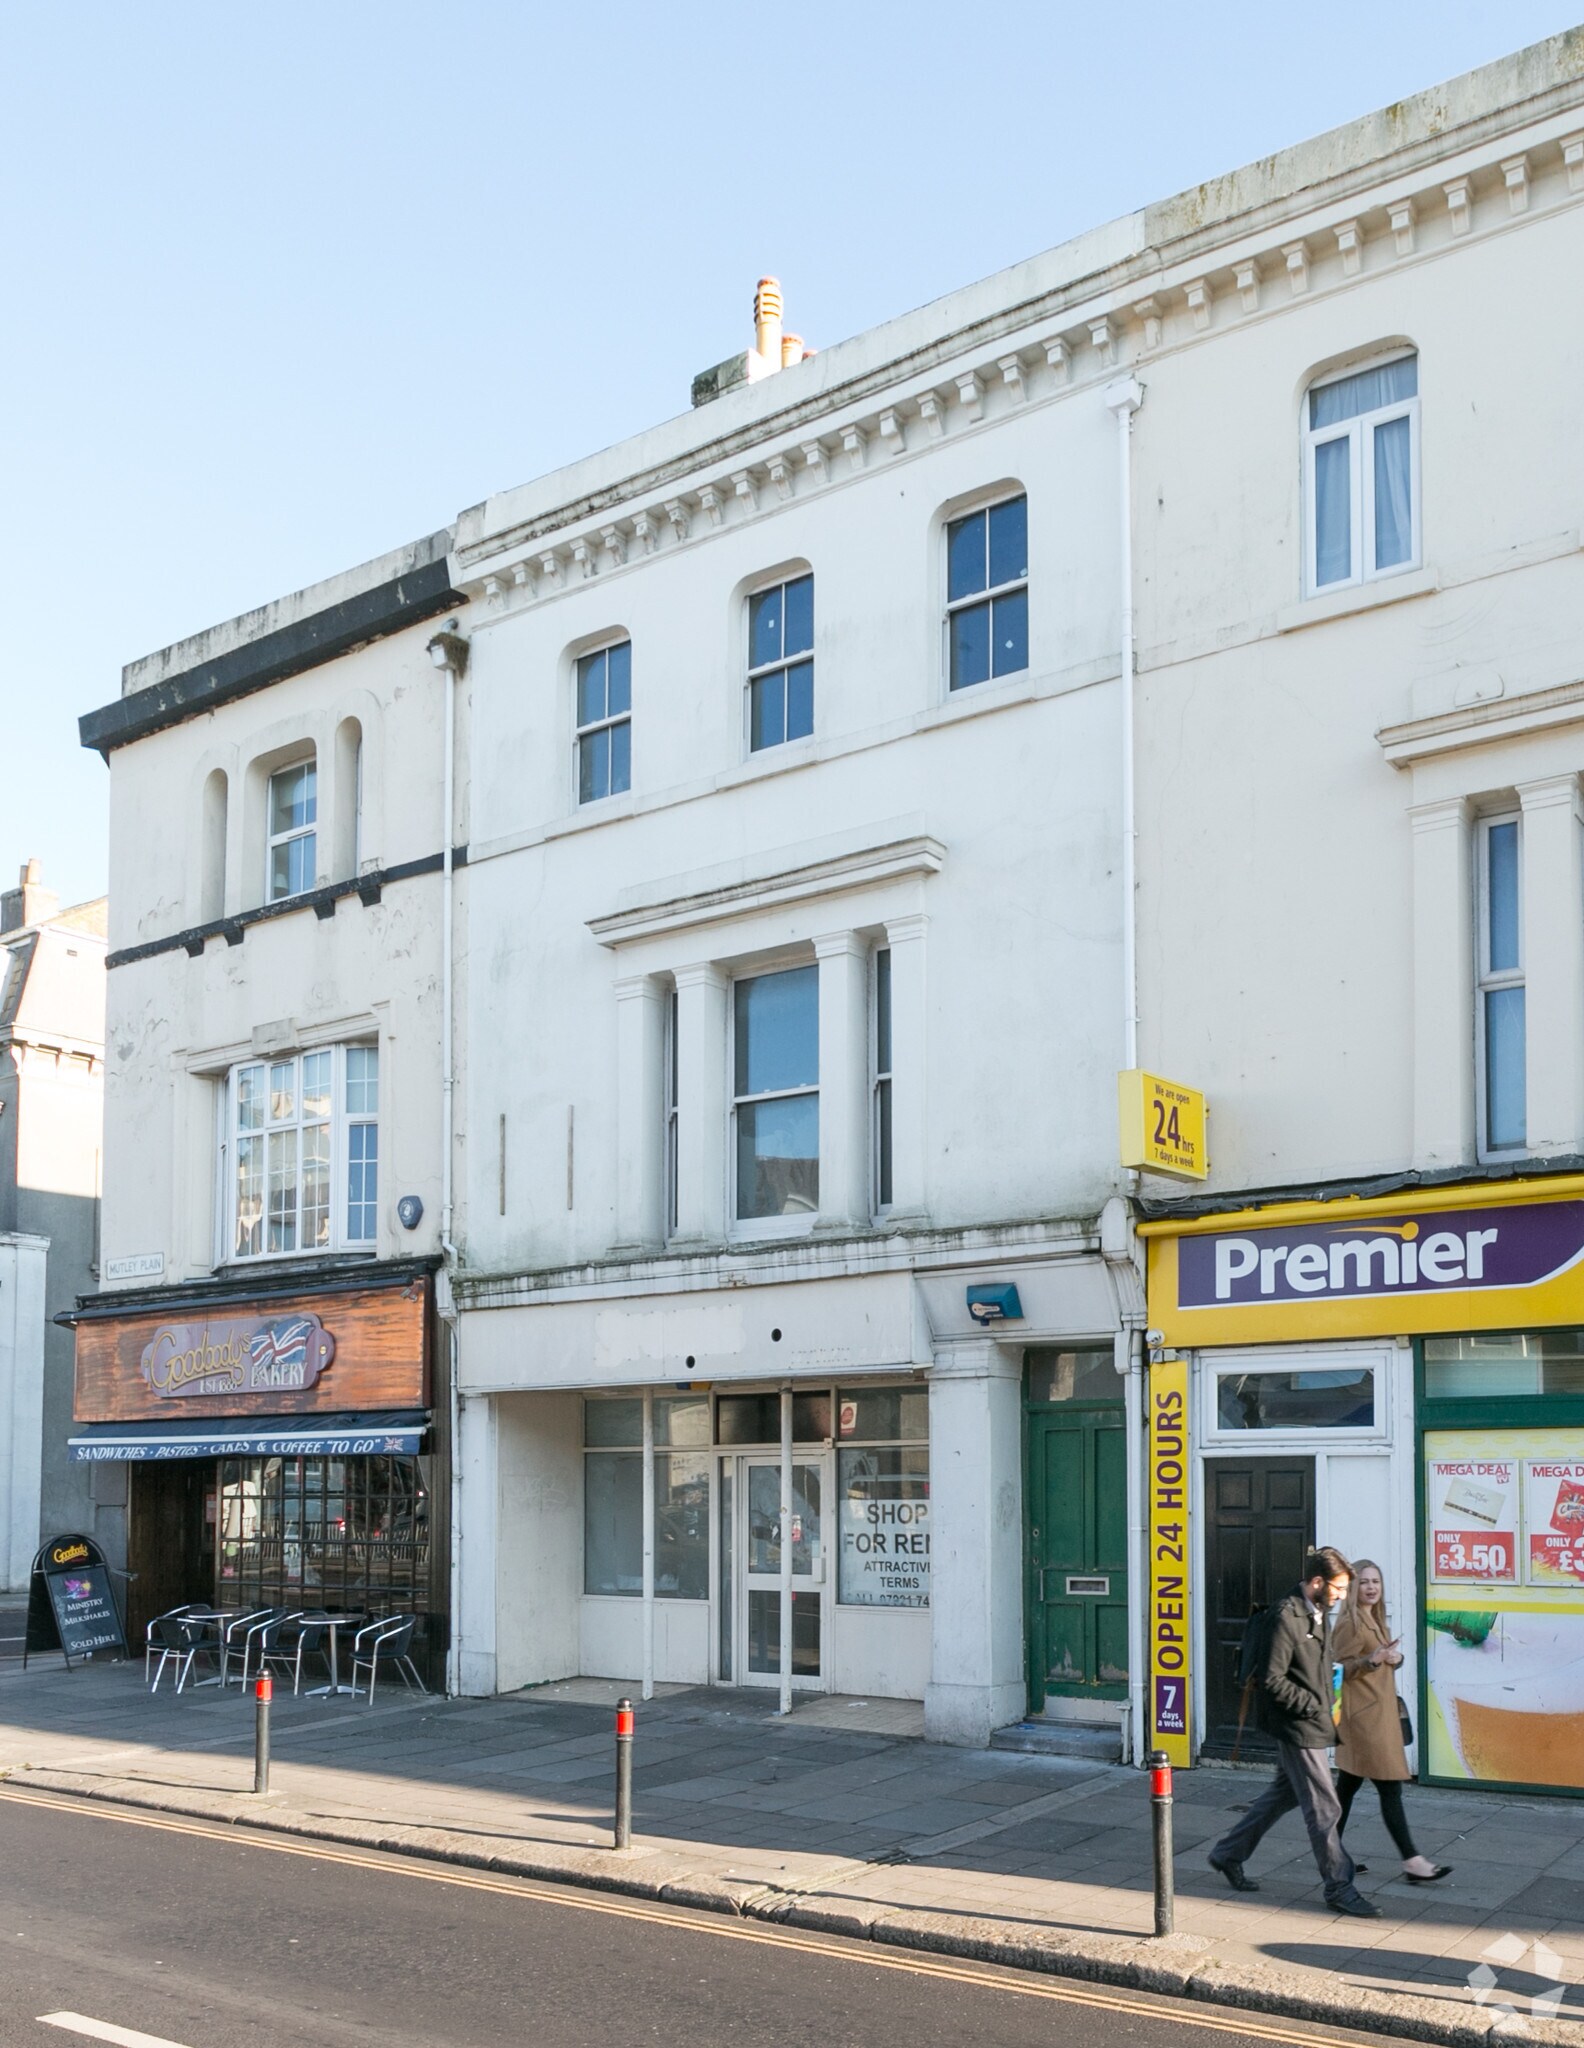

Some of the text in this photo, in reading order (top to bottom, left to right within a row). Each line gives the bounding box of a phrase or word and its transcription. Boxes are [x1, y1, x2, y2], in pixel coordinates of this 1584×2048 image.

[1155, 1083, 1190, 1105] We are open
[1153, 1100, 1195, 1154] 24 hrs
[1160, 1149, 1173, 1164] days
[1179, 1156, 1194, 1168] week
[110, 1258, 161, 1274] MUTLEY PLAIN
[1215, 1221, 1498, 1299] Premier
[151, 1328, 251, 1394] Goodbody's
[251, 1362, 308, 1388] BAKERY
[200, 1378, 217, 1393] EST
[77, 1446, 147, 1460] SANDWICHES
[154, 1445, 201, 1458] PASTIES
[210, 1441, 250, 1454] CAKES
[256, 1441, 267, 1452] &
[272, 1441, 324, 1453] COFFEE
[1437, 1463, 1511, 1475] MEGA DEAL
[1532, 1466, 1572, 1477] MEGA
[867, 1504, 928, 1524] SHOP
[1156, 1391, 1184, 1671] OPEN 24 HOURS
[1437, 1533, 1461, 1543] ONLY
[844, 1533, 887, 1554] FOR
[1546, 1537, 1570, 1547] ONLY
[1439, 1544, 1506, 1572] £3.50
[880, 1577, 920, 1588] TERMS
[67, 1598, 103, 1612] MINISTRY
[64, 1610, 110, 1625] MILKSHAKES
[71, 1634, 116, 1650] SOLD HERE
[1163, 1685, 1176, 1709] 7
[1162, 1710, 1179, 1720] days
[1164, 1719, 1184, 1728] week
